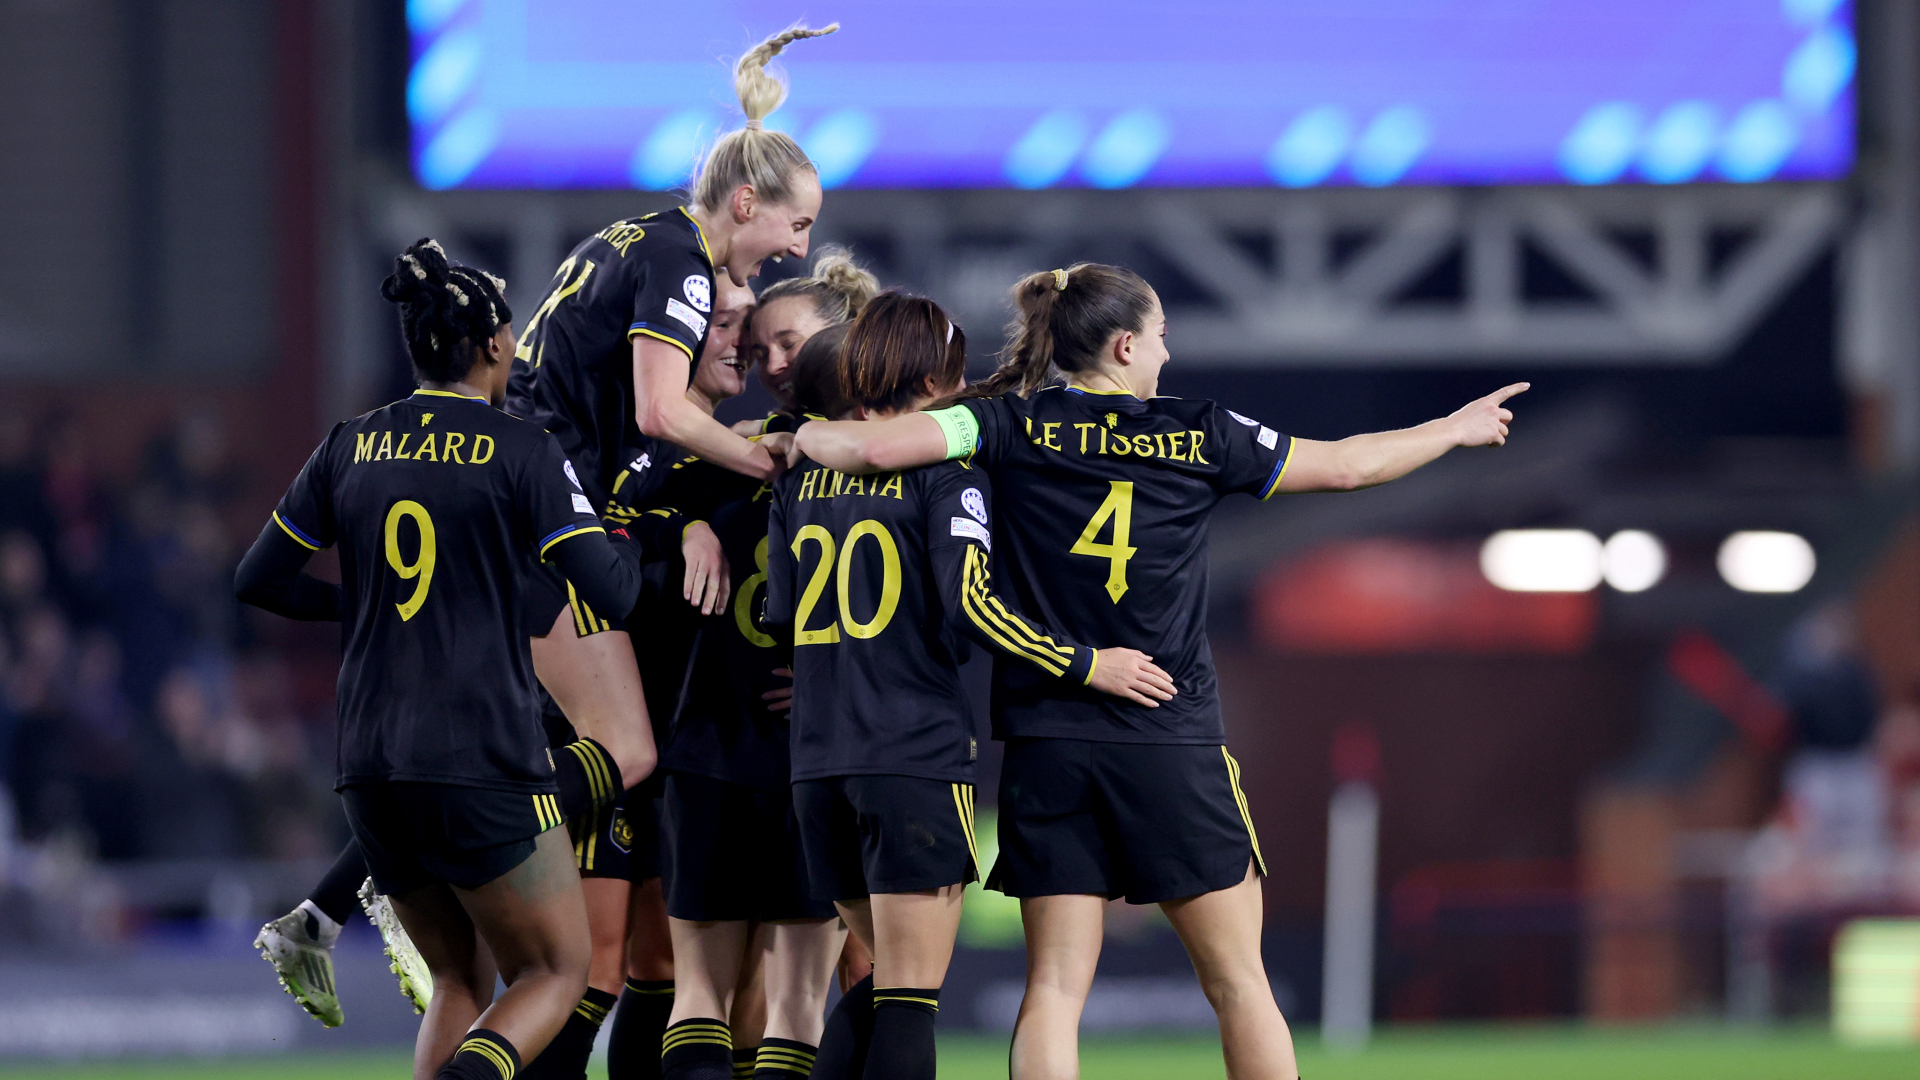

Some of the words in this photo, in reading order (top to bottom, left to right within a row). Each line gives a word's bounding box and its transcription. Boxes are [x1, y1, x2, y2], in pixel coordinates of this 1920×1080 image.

[353, 430, 496, 465] MALARD
[1024, 415, 1063, 452] LE
[1073, 422, 1210, 465] TISSIER
[384, 499, 437, 623] 9
[790, 519, 902, 647] 20
[1069, 480, 1138, 605] 4
